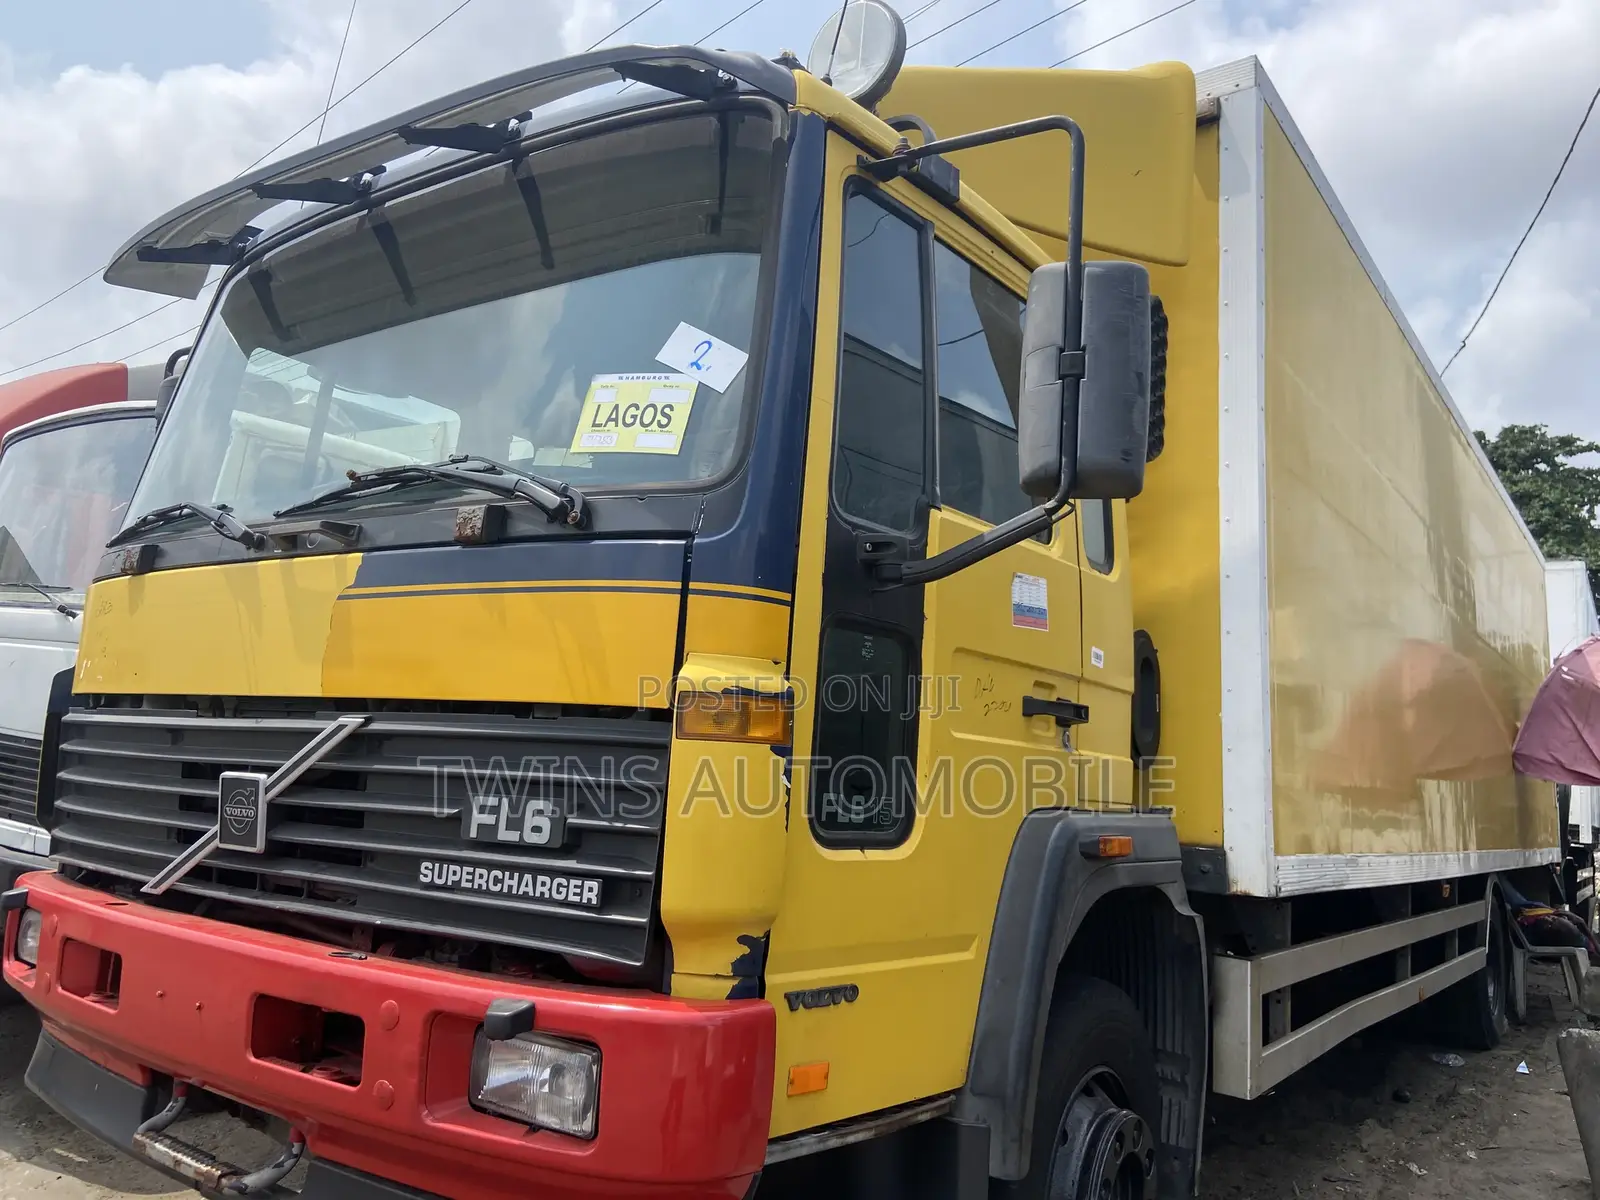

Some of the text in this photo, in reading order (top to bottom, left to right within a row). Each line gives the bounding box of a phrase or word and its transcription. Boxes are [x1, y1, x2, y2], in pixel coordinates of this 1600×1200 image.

[591, 403, 675, 429] LAGOS
[225, 807, 255, 818] VOLVO
[469, 796, 553, 845] FL6
[419, 861, 600, 905] SUPERCHARGER
[783, 983, 860, 1012] VOLVO
